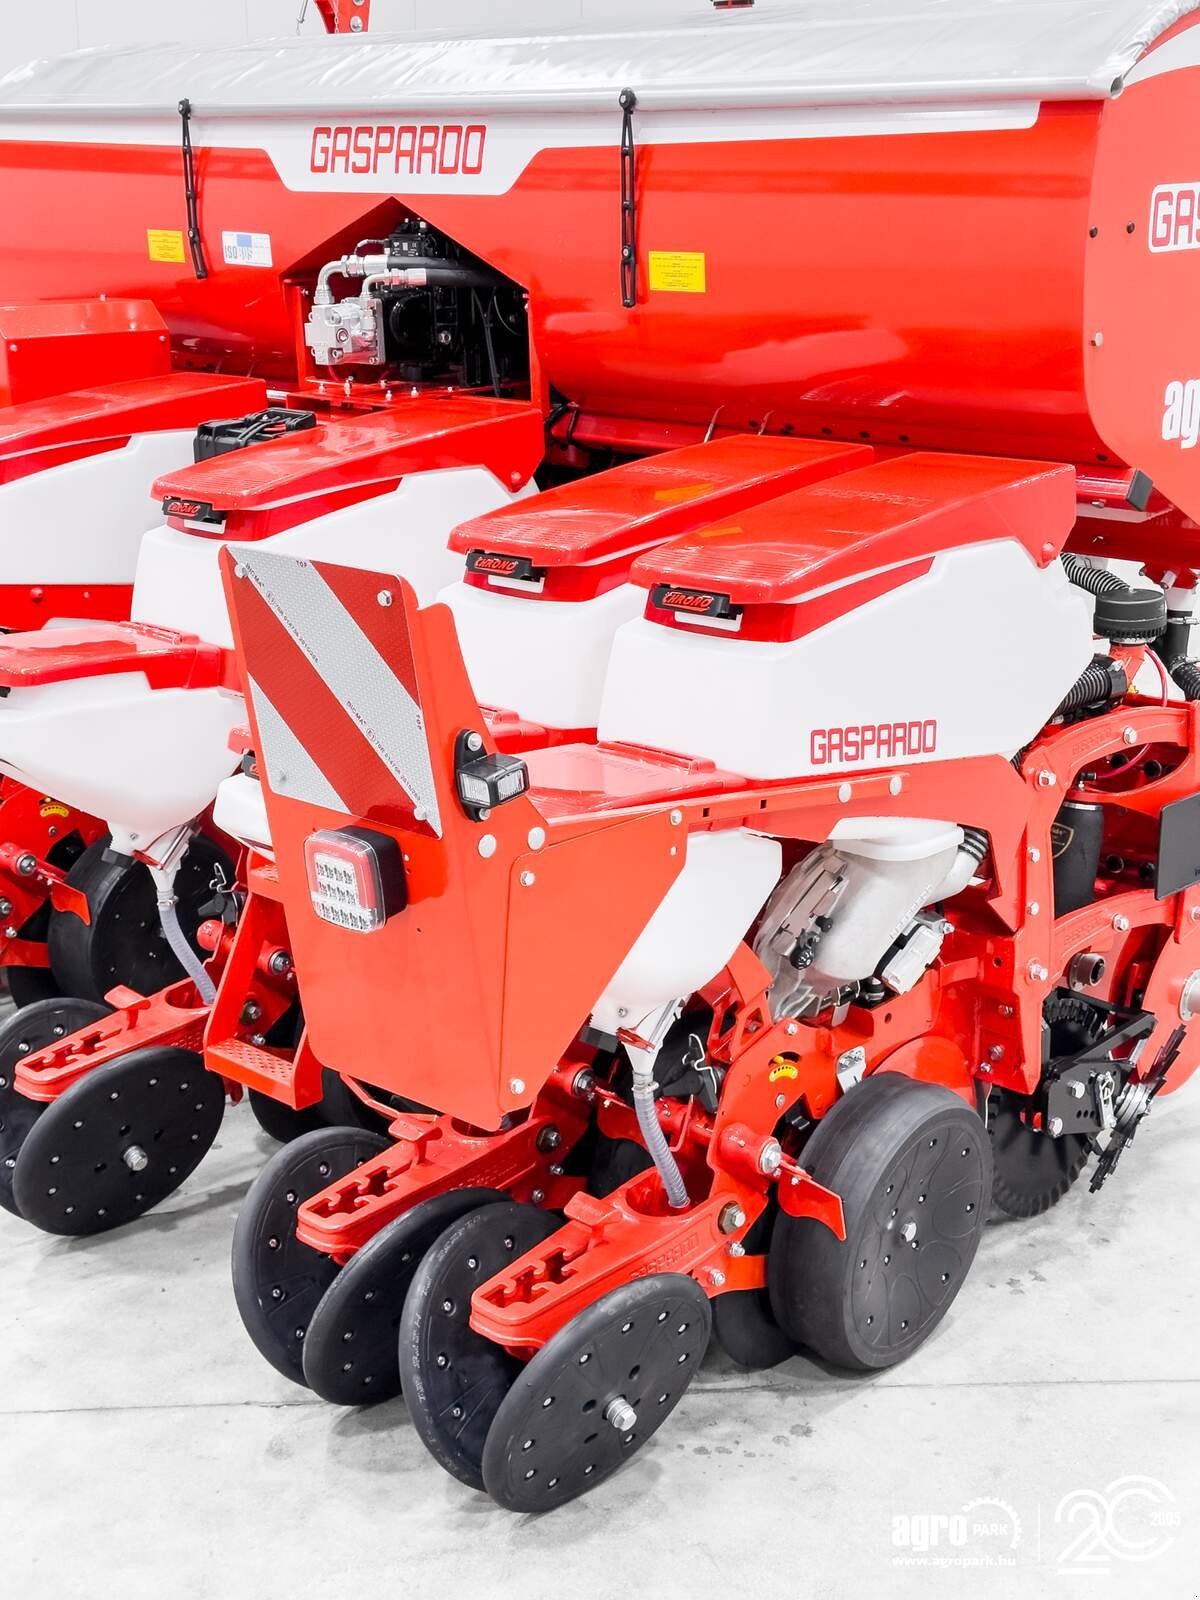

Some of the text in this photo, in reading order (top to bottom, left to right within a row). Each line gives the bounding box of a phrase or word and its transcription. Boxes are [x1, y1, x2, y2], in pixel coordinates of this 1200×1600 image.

[310, 124, 487, 175] GASPARDO
[1152, 188, 1200, 248] GA
[295, 560, 308, 568] TOP
[474, 556, 518, 572] CHRONO
[663, 591, 713, 609] CHRONO
[810, 719, 937, 765] GASPARDO
